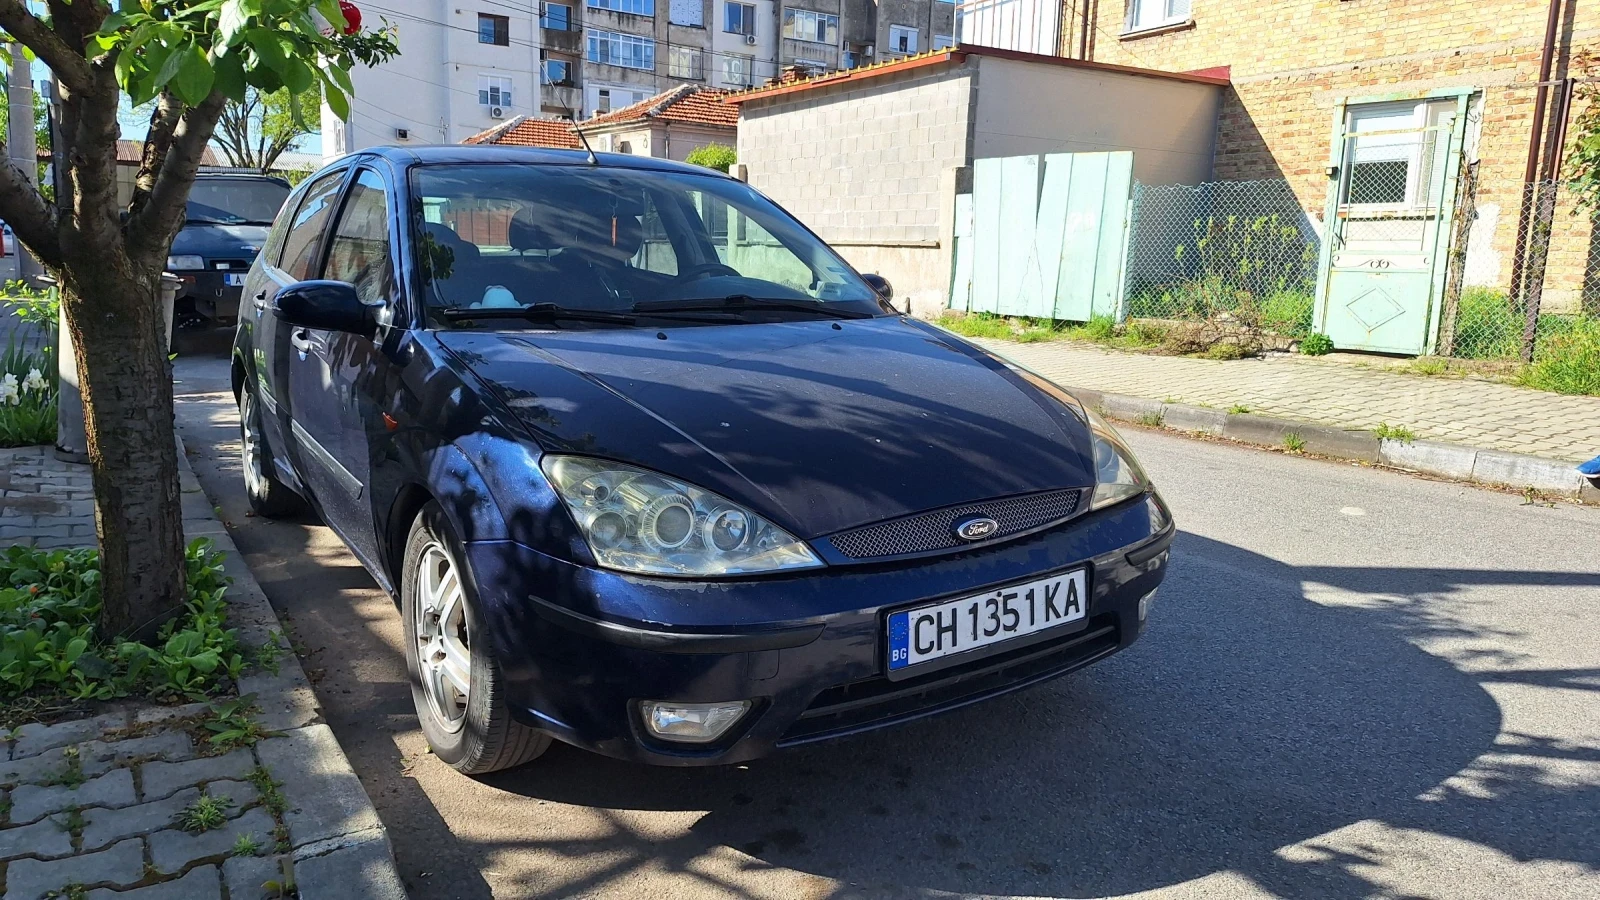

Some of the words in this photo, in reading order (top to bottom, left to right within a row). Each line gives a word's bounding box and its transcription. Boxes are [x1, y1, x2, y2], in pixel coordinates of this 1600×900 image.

[968, 522, 989, 536] Ford
[914, 607, 958, 655] CH
[968, 588, 1035, 641] 1351
[1044, 578, 1080, 622] KA
[892, 648, 907, 662] BG
